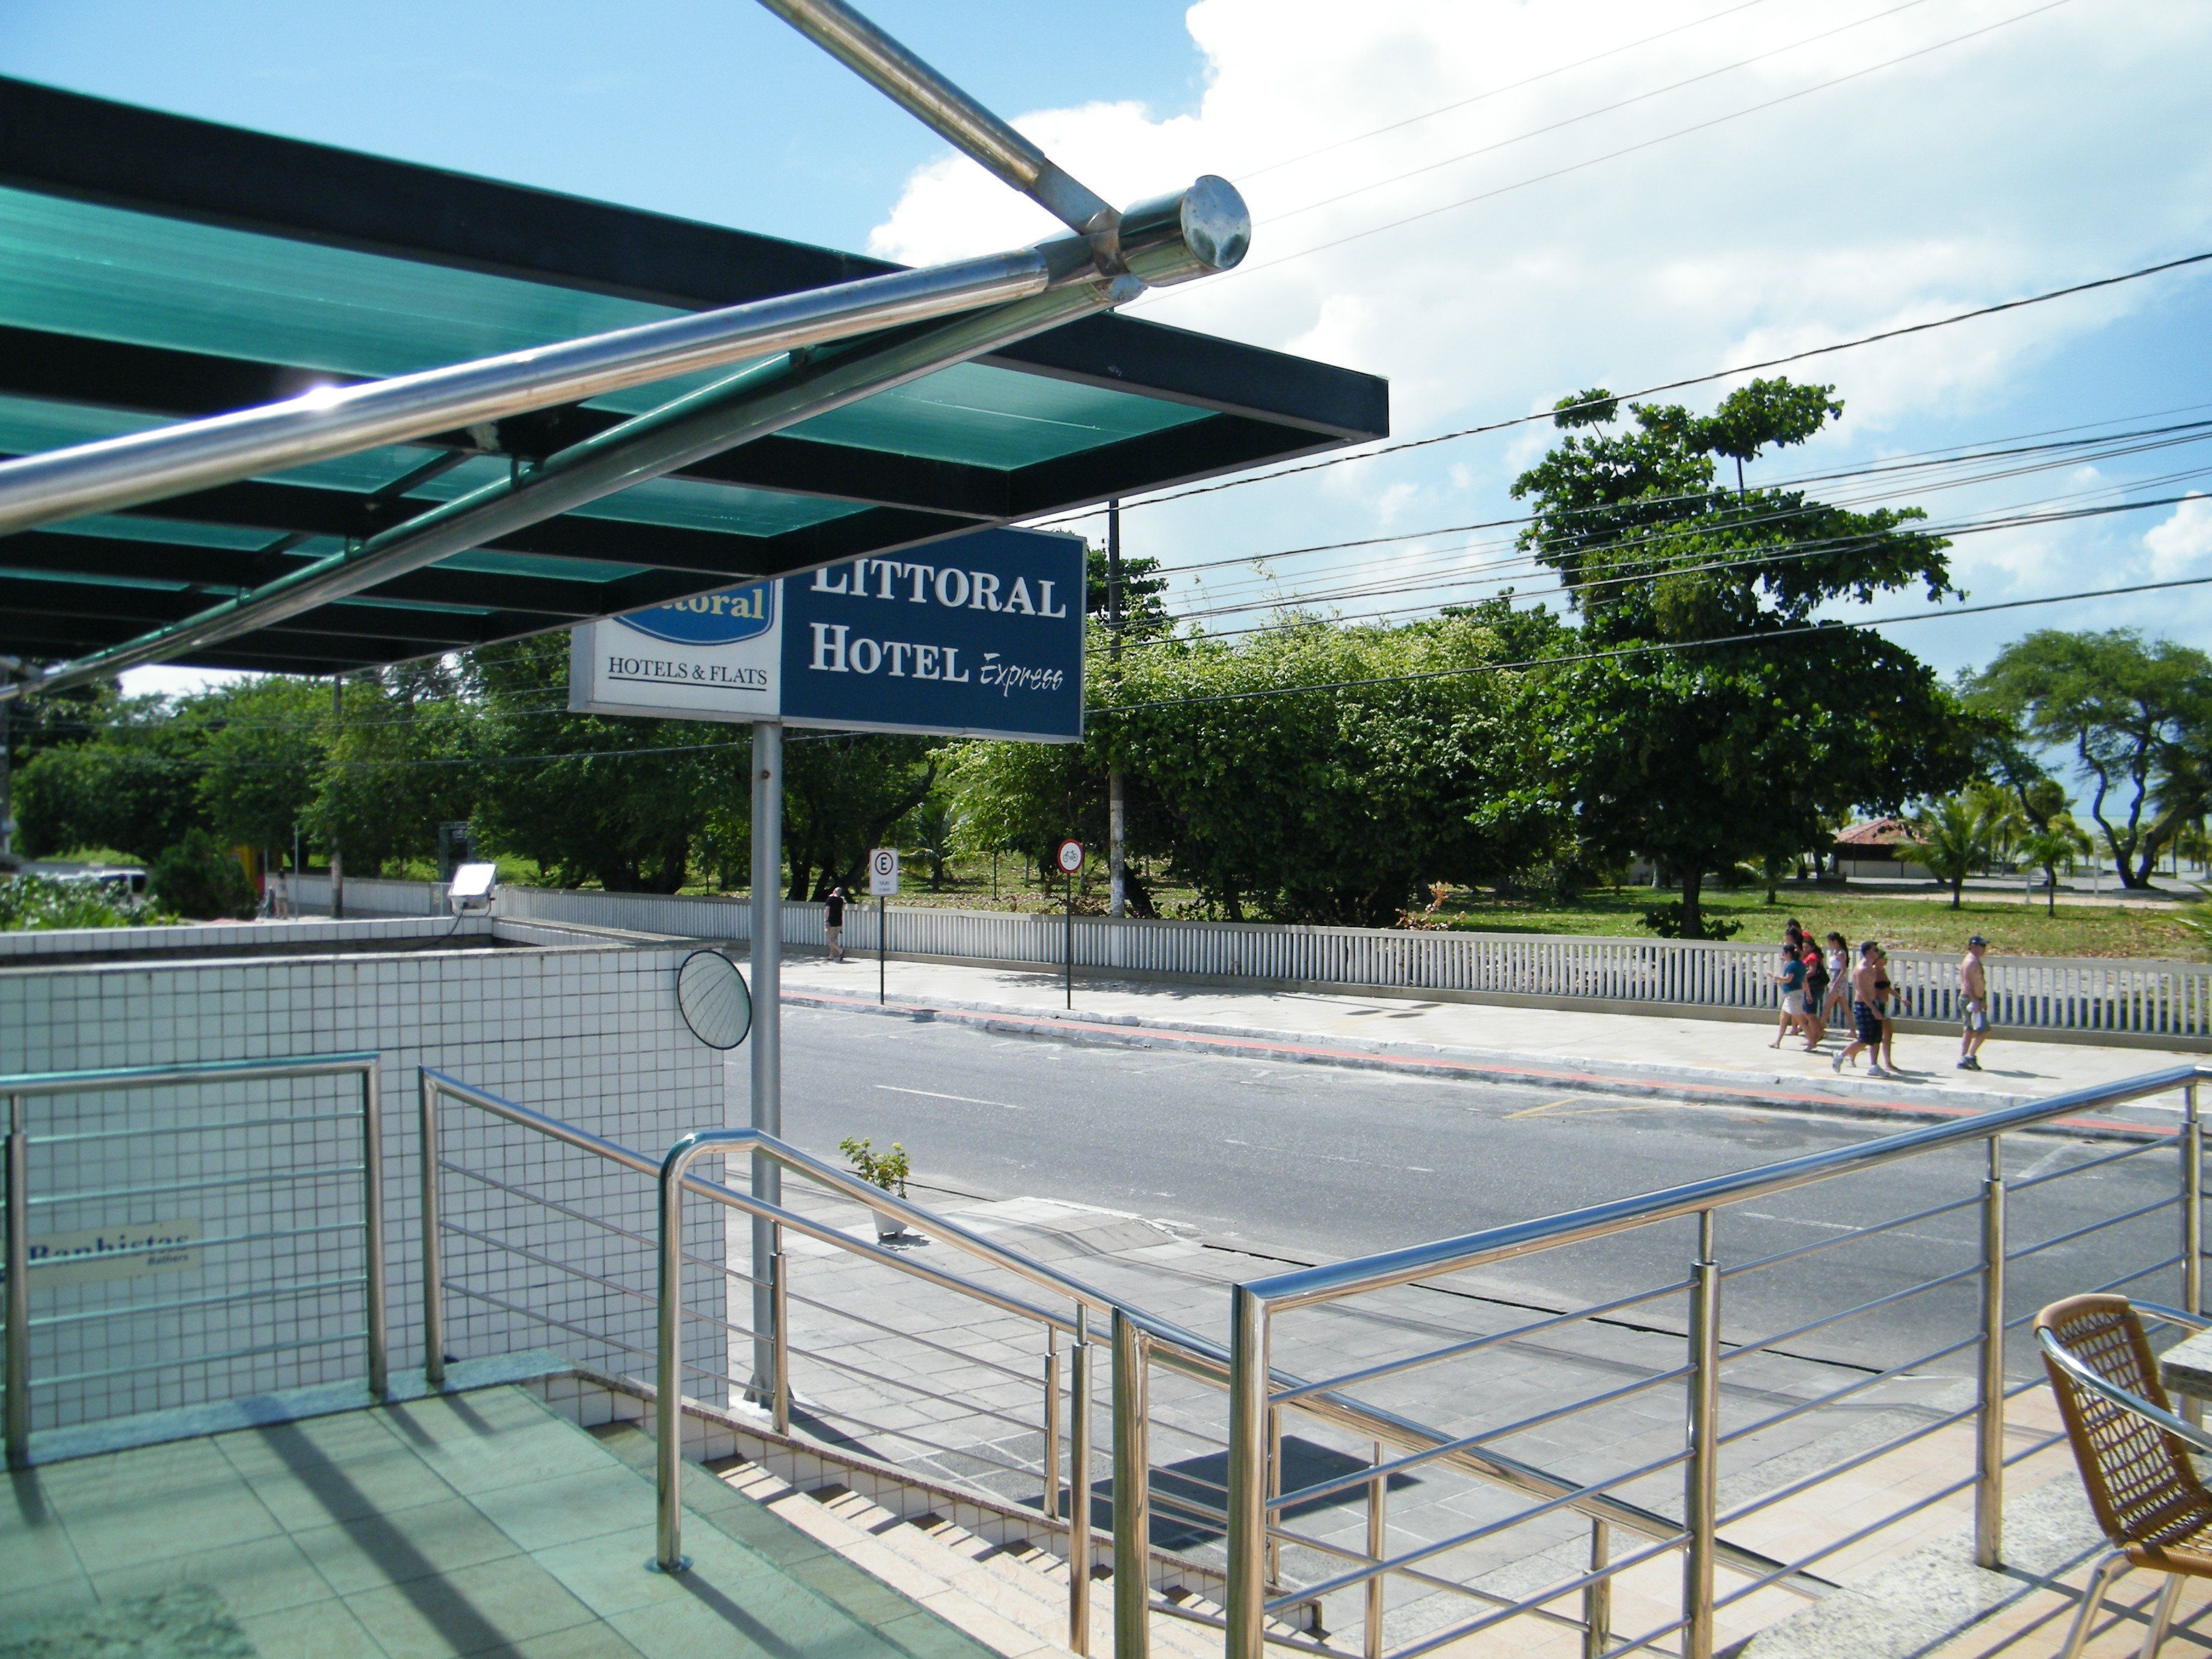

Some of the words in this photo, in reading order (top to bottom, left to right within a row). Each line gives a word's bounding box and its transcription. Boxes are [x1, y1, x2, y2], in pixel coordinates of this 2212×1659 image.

[809, 559, 1066, 618] LITTORAL
[608, 657, 688, 679] HOTELS
[692, 665, 705, 680] &
[709, 666, 767, 685] FLATS
[809, 622, 969, 683] HOTEL
[979, 652, 1064, 697] Express
[881, 857, 887, 870] E
